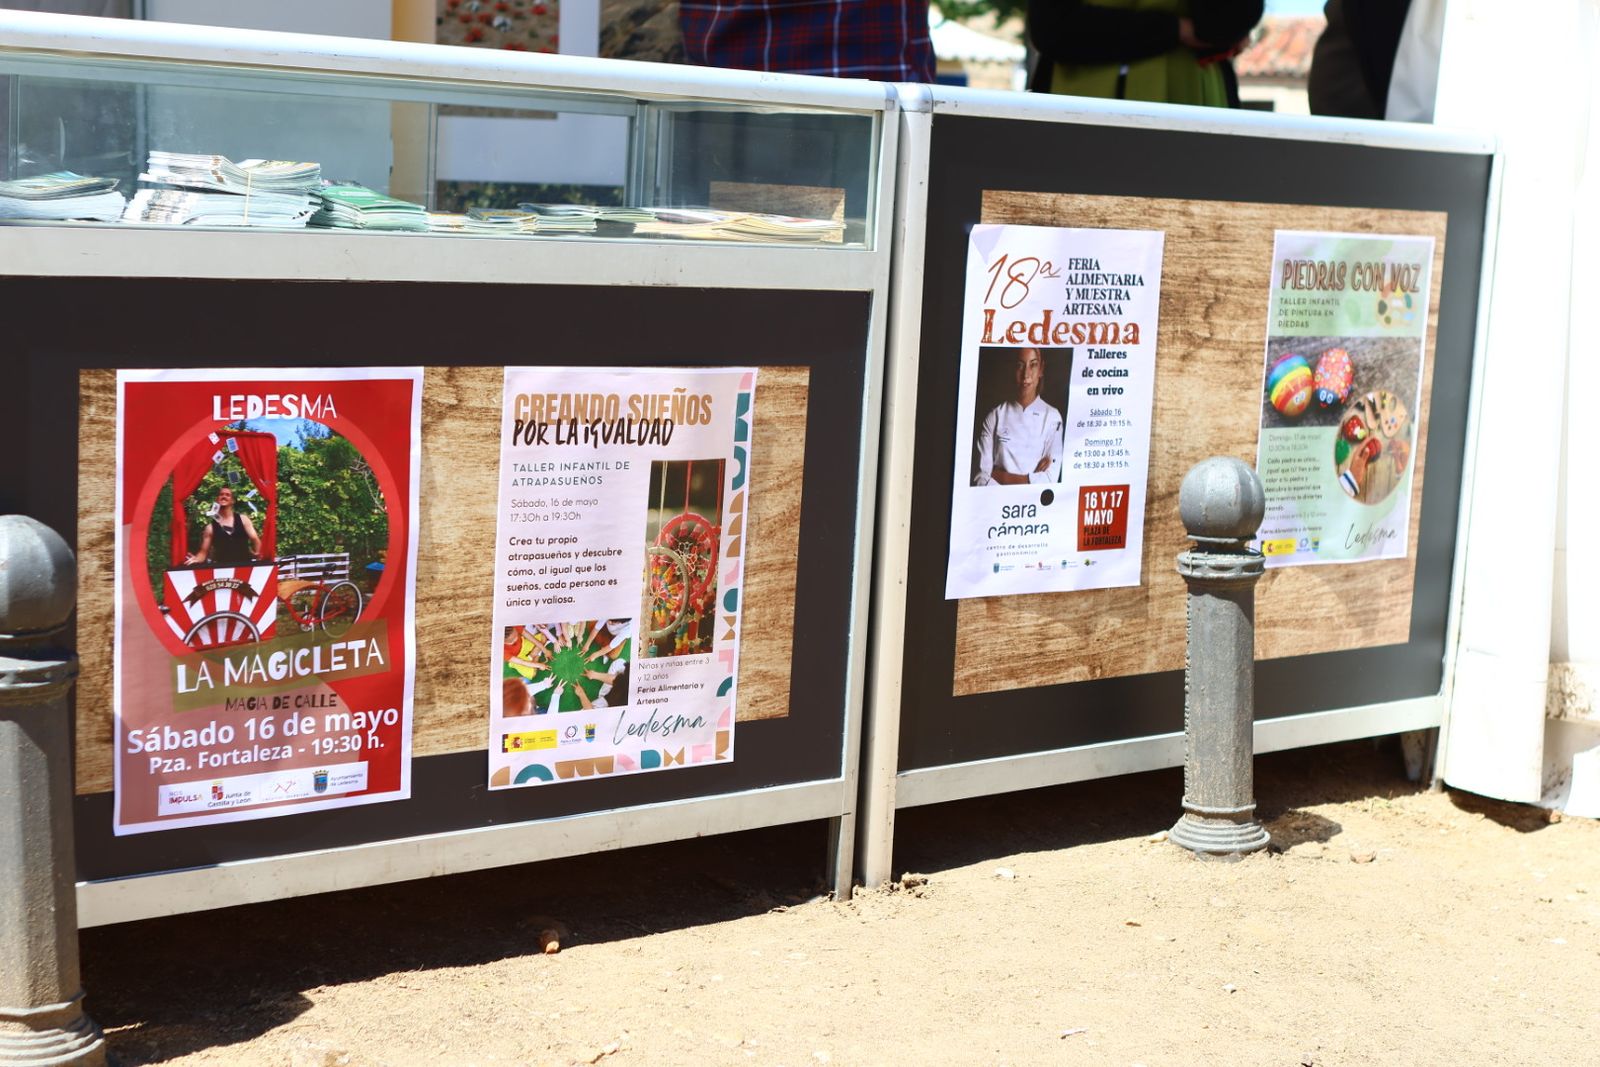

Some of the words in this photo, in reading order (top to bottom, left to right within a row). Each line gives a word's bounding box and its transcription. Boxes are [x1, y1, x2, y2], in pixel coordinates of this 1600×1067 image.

[1068, 258, 1101, 271] FERIA
[1066, 274, 1145, 287] ALIMENTARIA
[1281, 259, 1347, 292] PIEDRAS
[1351, 261, 1386, 292] CON
[1390, 262, 1421, 293] VOZ
[1066, 288, 1075, 301] Y
[1075, 288, 1131, 301] MUESTRA
[1280, 298, 1307, 306] TALLER
[1309, 298, 1341, 306] INFANTIL
[1063, 303, 1124, 316] ARTESANA
[980, 309, 1141, 346] Ledesma
[1087, 348, 1128, 360] Talleres
[1082, 367, 1094, 378] de
[1096, 367, 1129, 378] cocina
[1087, 386, 1099, 396] en
[1102, 385, 1124, 396] vivo
[213, 393, 337, 422] LEDESMA
[514, 393, 622, 426] CREANDO
[628, 387, 713, 426] SUEÑOS
[1090, 408, 1113, 417] Sábado
[1115, 408, 1122, 416] 16
[512, 419, 549, 447] POR
[556, 417, 579, 446] LA
[1085, 439, 1114, 447] Domingo
[1115, 438, 1123, 446] 17
[513, 463, 555, 473] TALLER
[560, 462, 611, 472] INFANTIL
[616, 461, 631, 471] DE
[512, 475, 603, 488] ATRAPASUEÑOS
[511, 498, 548, 509] Sábado,
[551, 498, 560, 507] 16
[562, 498, 574, 507] de
[576, 499, 599, 508] mayo
[1085, 492, 1098, 510] 16
[1101, 491, 1108, 509] Y
[1110, 491, 1124, 508] 17
[510, 512, 541, 523] 17:30h
[552, 511, 582, 522] 19:30h
[1002, 504, 1037, 519] sara
[1084, 509, 1114, 526] MAYO
[988, 523, 1050, 540] cámara
[1084, 526, 1101, 535] PLAZA
[1344, 522, 1398, 550] Ledesma
[509, 536, 532, 547] Crea
[536, 536, 545, 545] tu
[548, 535, 579, 547] propio
[508, 551, 572, 563] atrapasueños
[575, 552, 580, 561] y
[582, 547, 623, 558] descubre
[508, 566, 536, 578] cómo,
[539, 566, 548, 576] al
[550, 565, 573, 577] igual
[575, 566, 592, 576] que
[595, 563, 607, 573] los
[544, 579, 567, 591] cada
[570, 580, 606, 591] persona
[608, 578, 618, 586] es
[506, 597, 531, 608] única
[534, 599, 540, 608] y
[543, 595, 576, 605] valiosa.
[177, 661, 214, 694] LA
[224, 638, 385, 688] MAGICLETA
[637, 686, 656, 695] Feria
[658, 682, 699, 692] Alimentaria
[225, 696, 269, 712] MAGIA
[272, 695, 291, 711] DE
[295, 693, 338, 709] CALLE
[637, 697, 669, 706] Artesana
[127, 720, 235, 755] Sábado
[244, 717, 275, 741] 16
[283, 711, 316, 737] de
[325, 707, 400, 736] mayo
[612, 708, 707, 747] Ledesma
[149, 756, 192, 775] Pza.
[198, 744, 293, 770] Fortaleza
[311, 734, 361, 756] 19:30
[368, 731, 385, 750] h.
